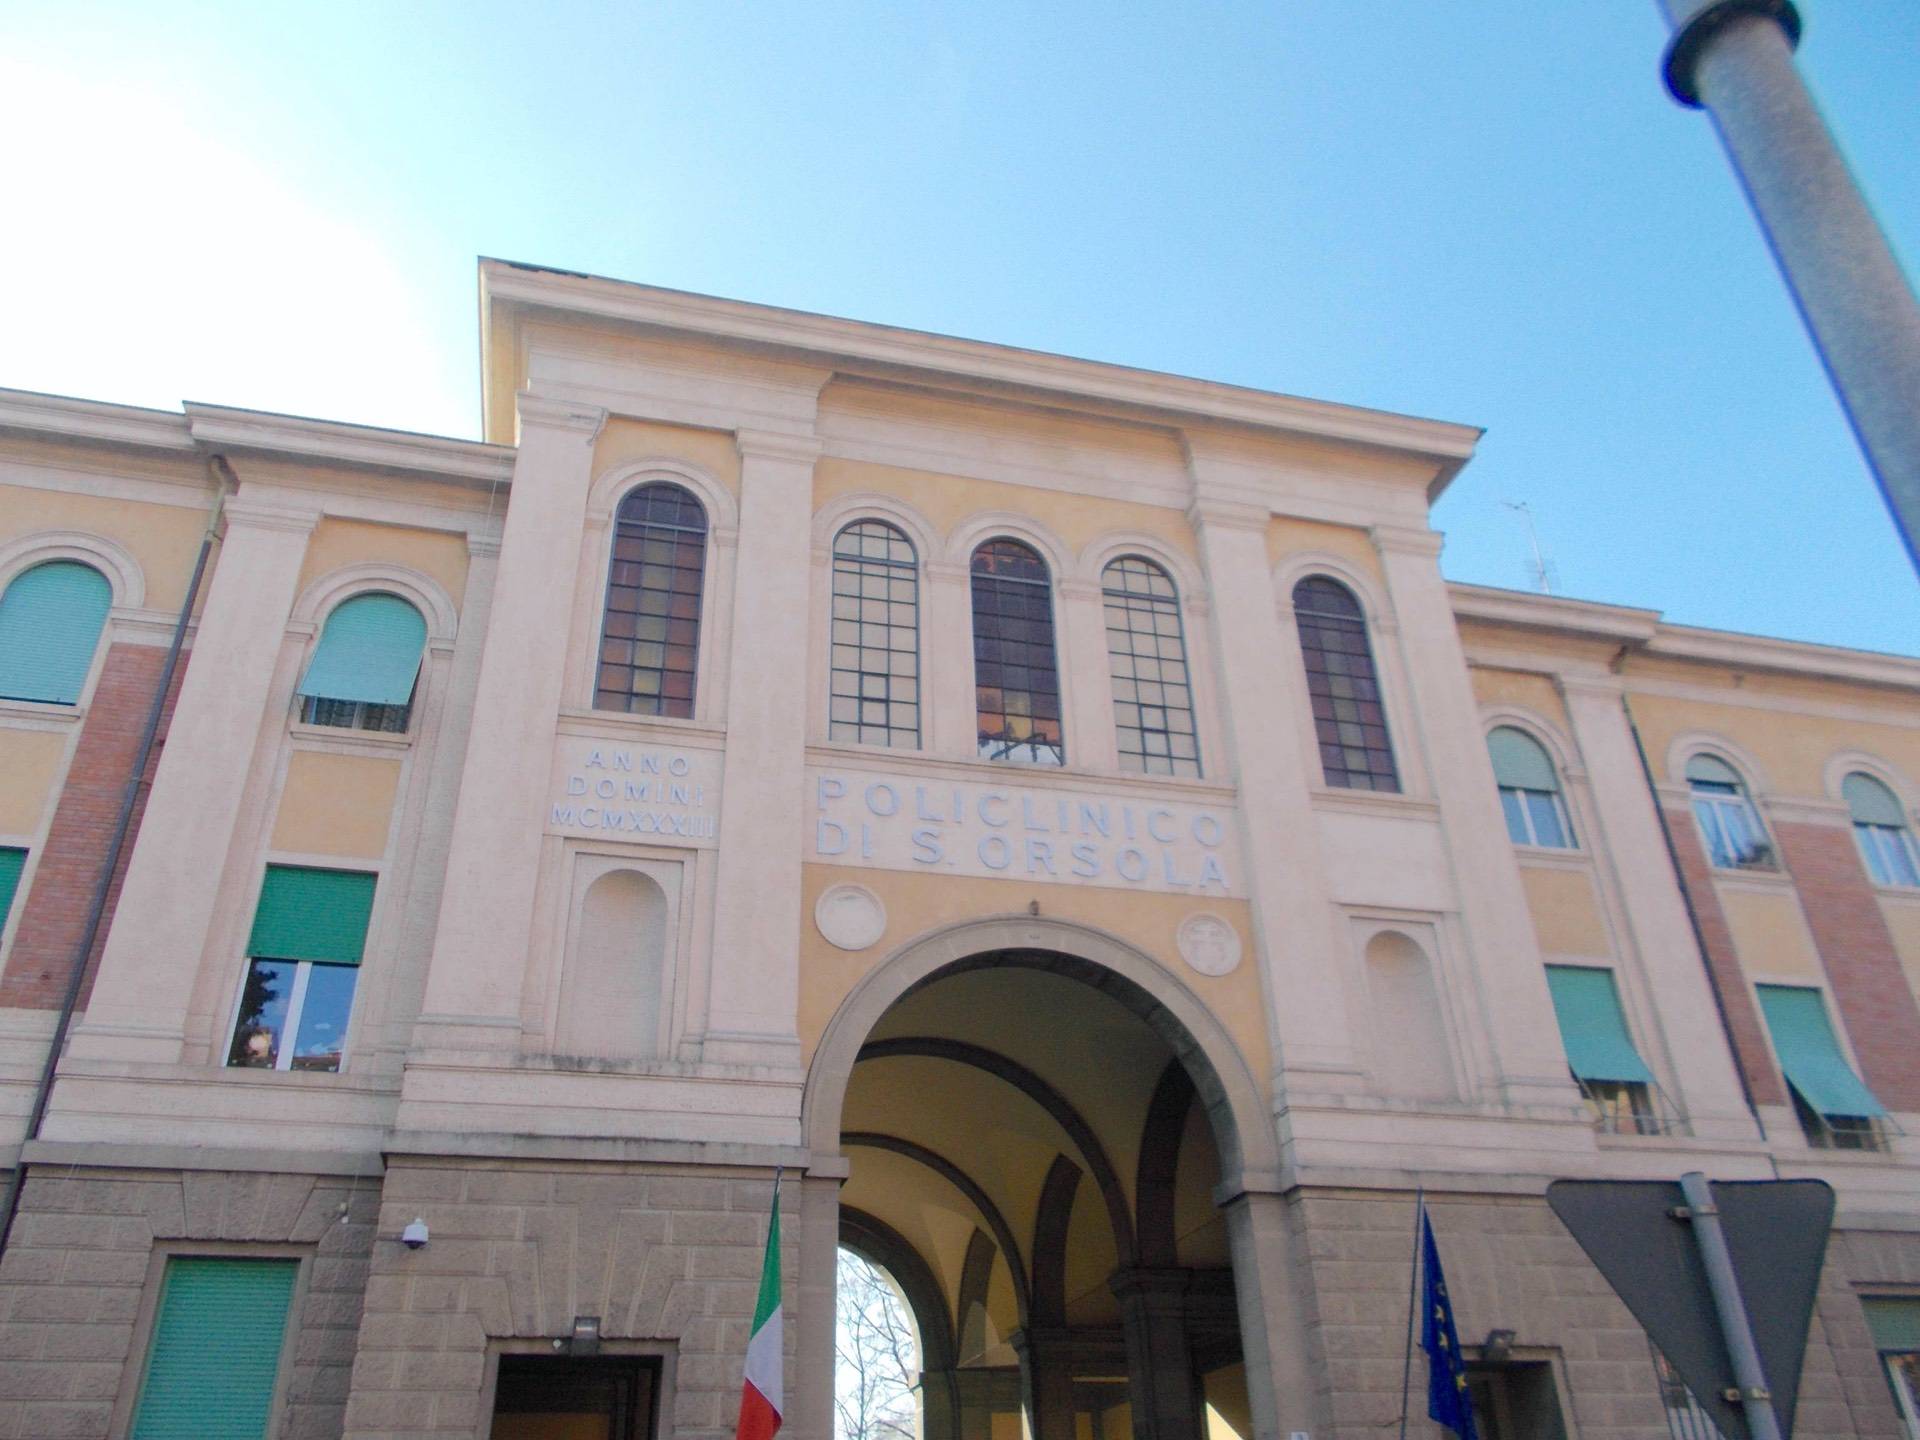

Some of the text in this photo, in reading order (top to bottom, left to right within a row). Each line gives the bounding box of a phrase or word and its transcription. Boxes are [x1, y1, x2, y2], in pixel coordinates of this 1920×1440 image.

[585, 749, 689, 777] ANNO
[567, 775, 704, 807] DOMINI
[816, 775, 1224, 848] POLICLINICO
[815, 816, 873, 859] DI
[977, 834, 1231, 889] ORSOLA
